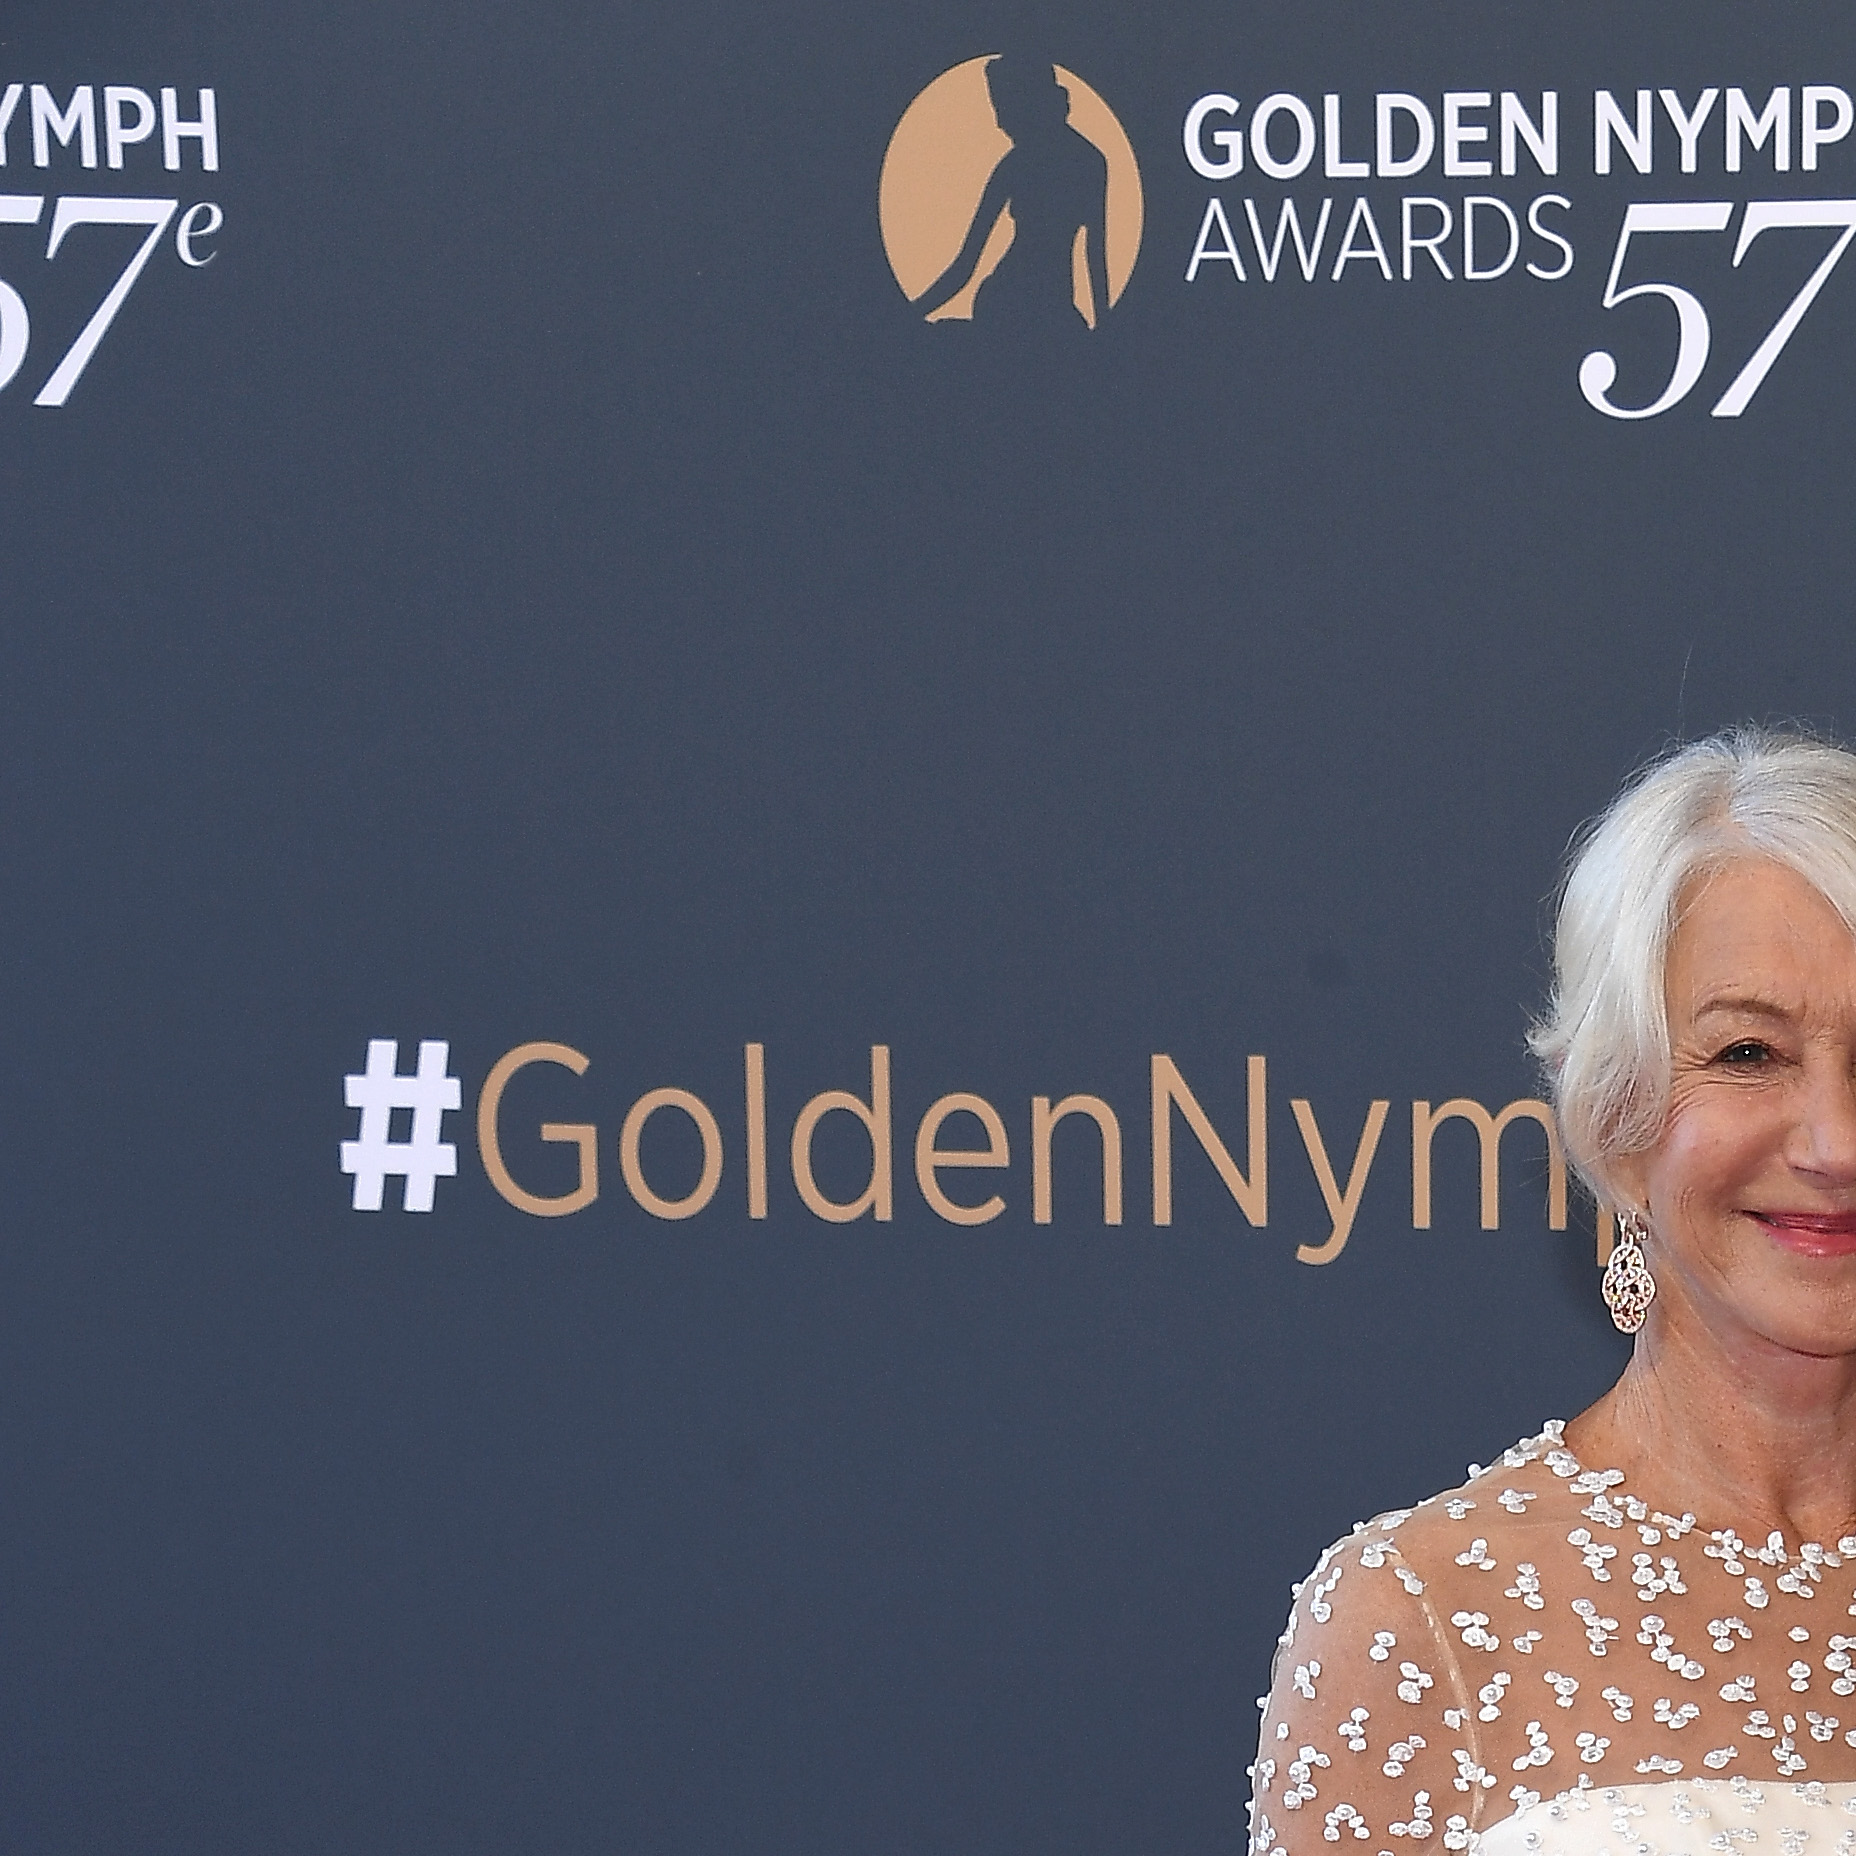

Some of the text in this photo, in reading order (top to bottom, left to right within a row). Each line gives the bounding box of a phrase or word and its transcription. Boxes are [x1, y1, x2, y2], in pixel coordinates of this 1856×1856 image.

[1183, 91, 1558, 180] GOLDEN
[1185, 194, 1574, 282] AWARDS
[340, 1038, 1615, 1267] #GoldenNym
